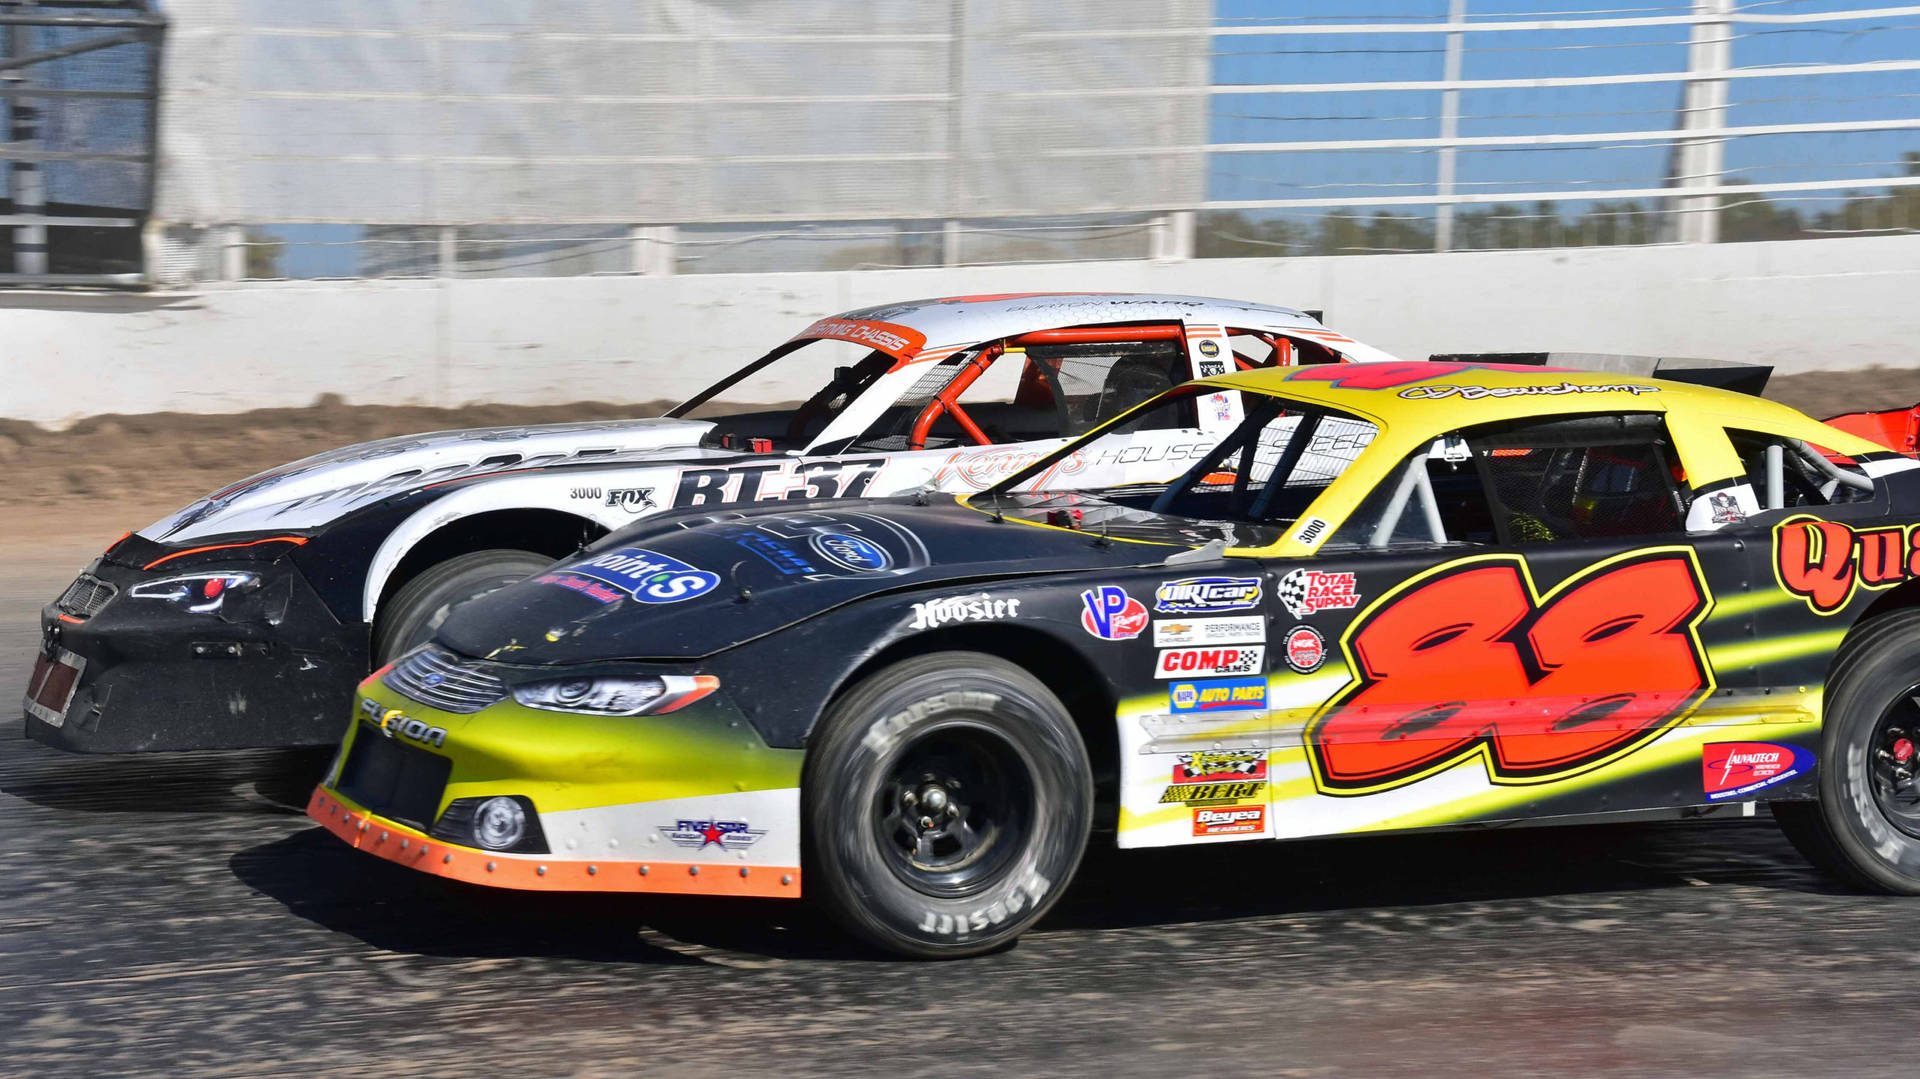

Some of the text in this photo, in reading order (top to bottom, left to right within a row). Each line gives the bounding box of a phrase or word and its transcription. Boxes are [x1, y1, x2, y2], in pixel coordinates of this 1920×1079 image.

[850, 325, 911, 352] CHASSIS
[1096, 443, 1213, 465] HOUSE
[1267, 432, 1377, 455] SEED
[570, 487, 602, 500] 3000
[606, 487, 654, 507] FOX
[1299, 519, 1326, 544] 3000
[822, 537, 874, 564] Ford
[572, 554, 669, 580] point
[1777, 515, 1920, 612] Qu
[1306, 572, 1354, 586] TOTAL
[1164, 583, 1255, 605] DIRTcar
[1308, 585, 1353, 598] RACE
[908, 593, 1021, 630] Hoosier
[1084, 586, 1127, 639] VP
[1305, 595, 1359, 613] SUPPLY
[1163, 650, 1239, 672] COMP
[1214, 664, 1251, 674] CAMS
[1310, 550, 1711, 792] 88
[1199, 688, 1230, 702] AUTO
[1232, 686, 1265, 701] PARTS
[1188, 783, 1258, 800] BERT
[1197, 810, 1261, 826] Beyea
